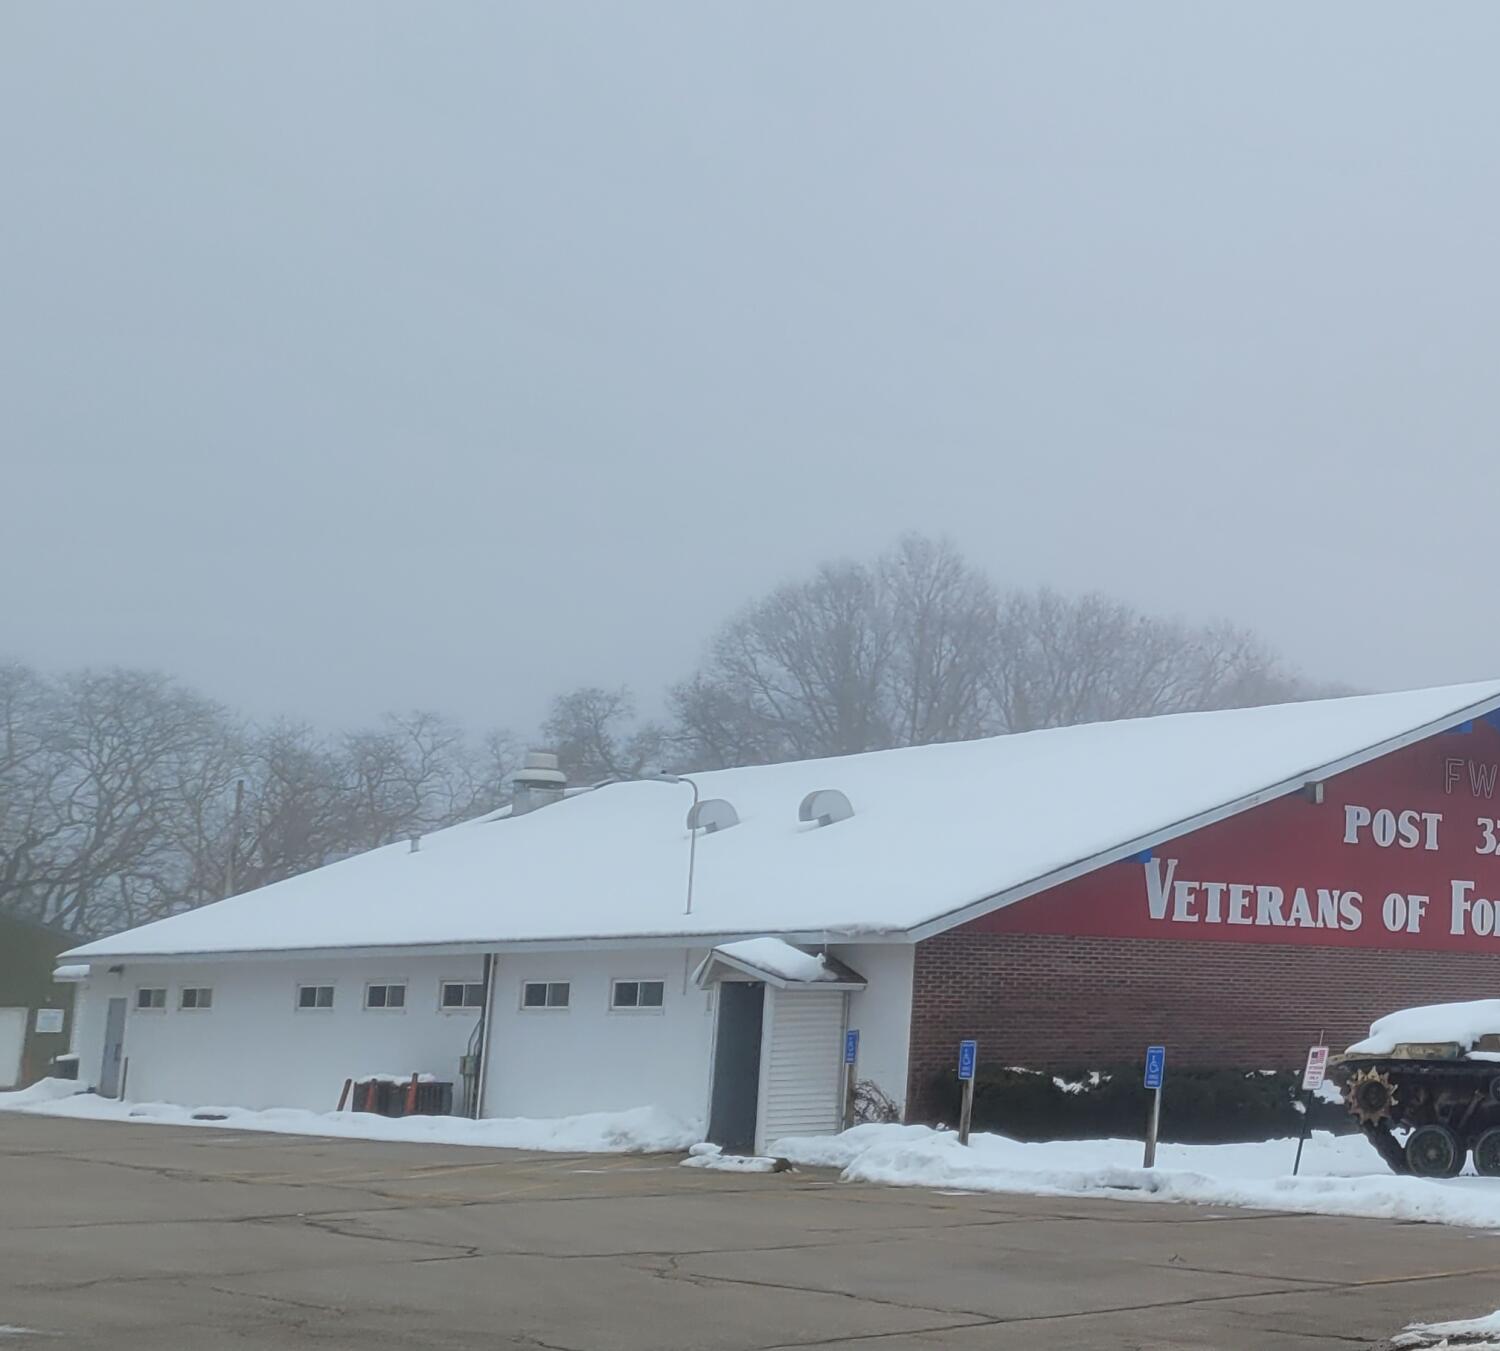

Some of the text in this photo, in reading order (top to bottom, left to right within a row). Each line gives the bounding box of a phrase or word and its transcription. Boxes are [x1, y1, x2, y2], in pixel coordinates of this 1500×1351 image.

[1445, 757, 1498, 799] FW
[1343, 804, 1443, 851] POST
[1144, 857, 1363, 931] VETERANS
[1382, 892, 1430, 933] OF
